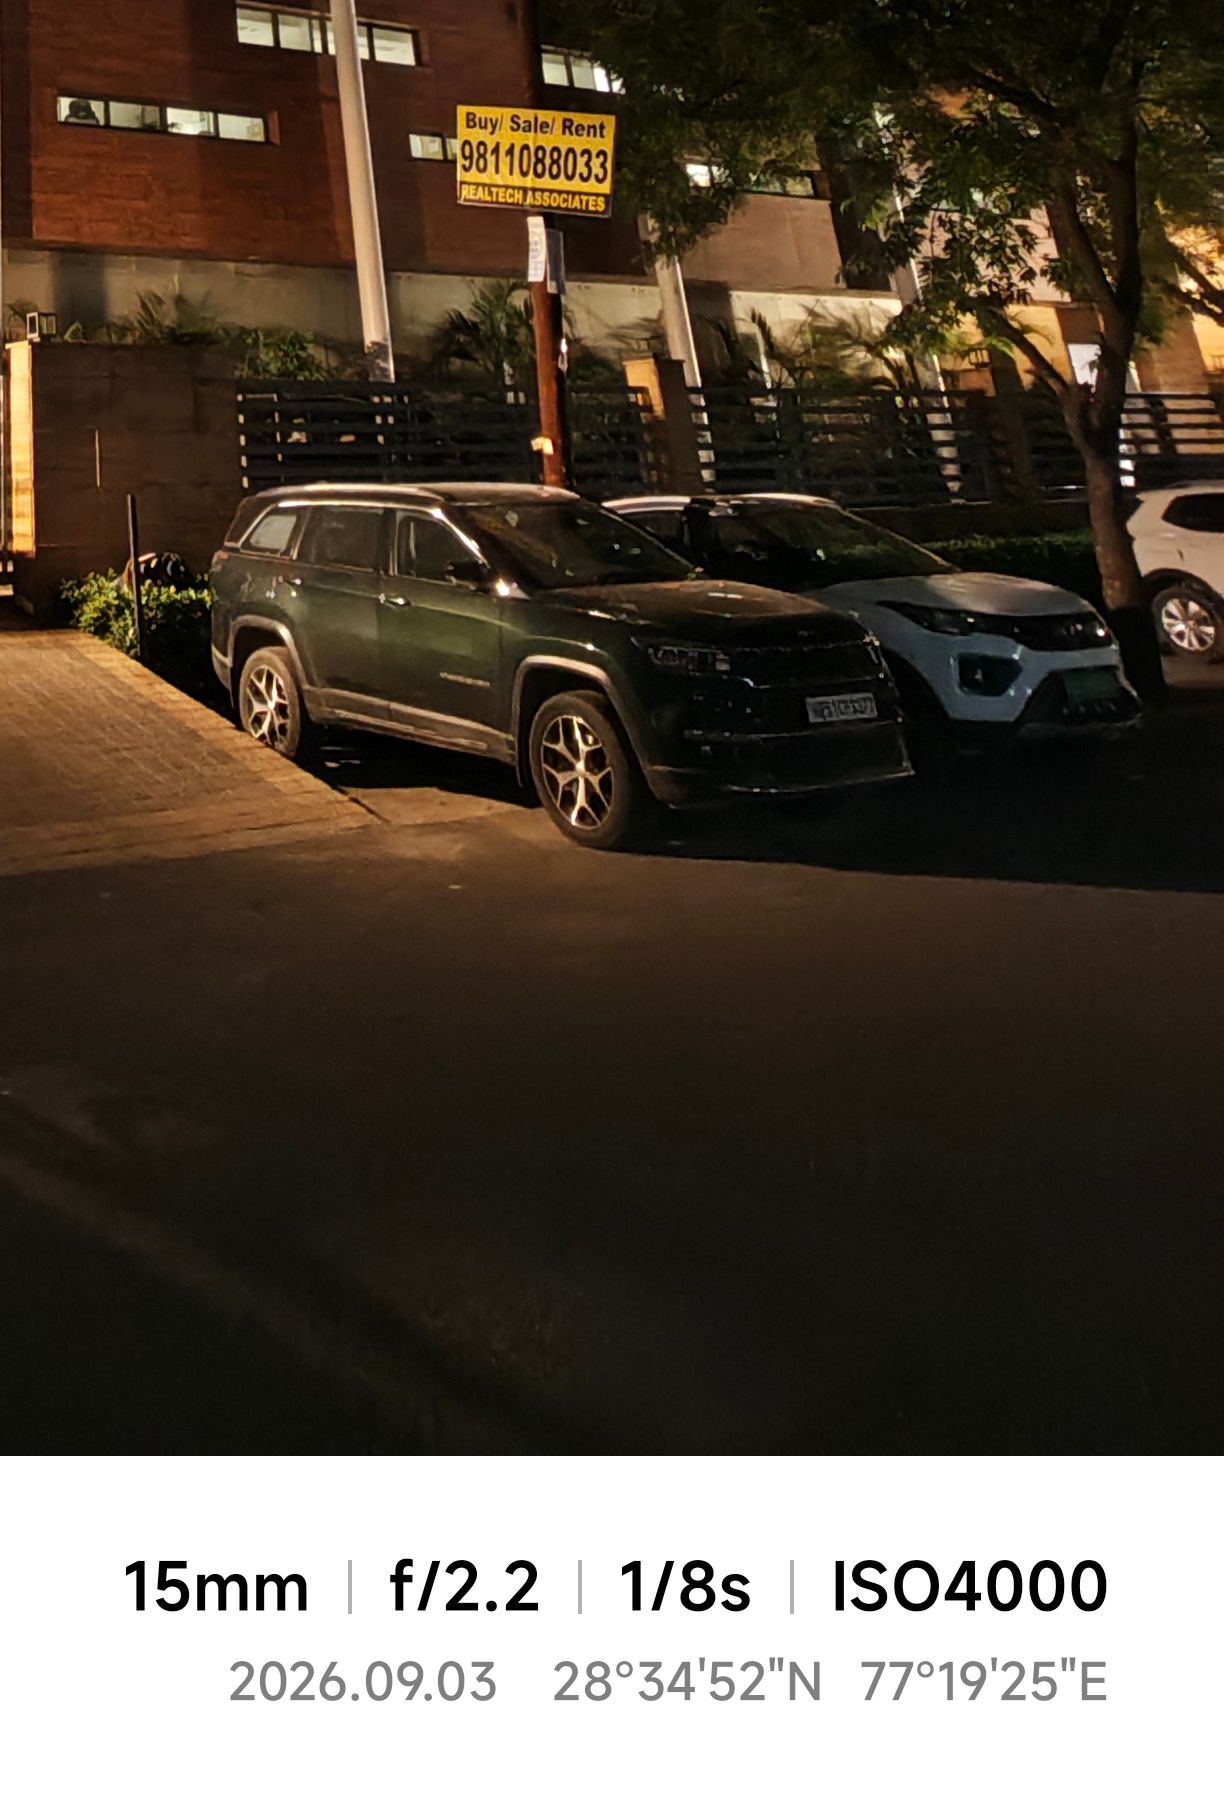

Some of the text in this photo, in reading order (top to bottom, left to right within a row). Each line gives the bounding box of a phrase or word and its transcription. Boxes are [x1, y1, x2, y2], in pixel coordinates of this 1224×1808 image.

[465, 111, 607, 139] Buy/ Sale/ Rent
[460, 139, 609, 185] 9811088033
[460, 183, 607, 212] REALTECH ASSOCIATES
